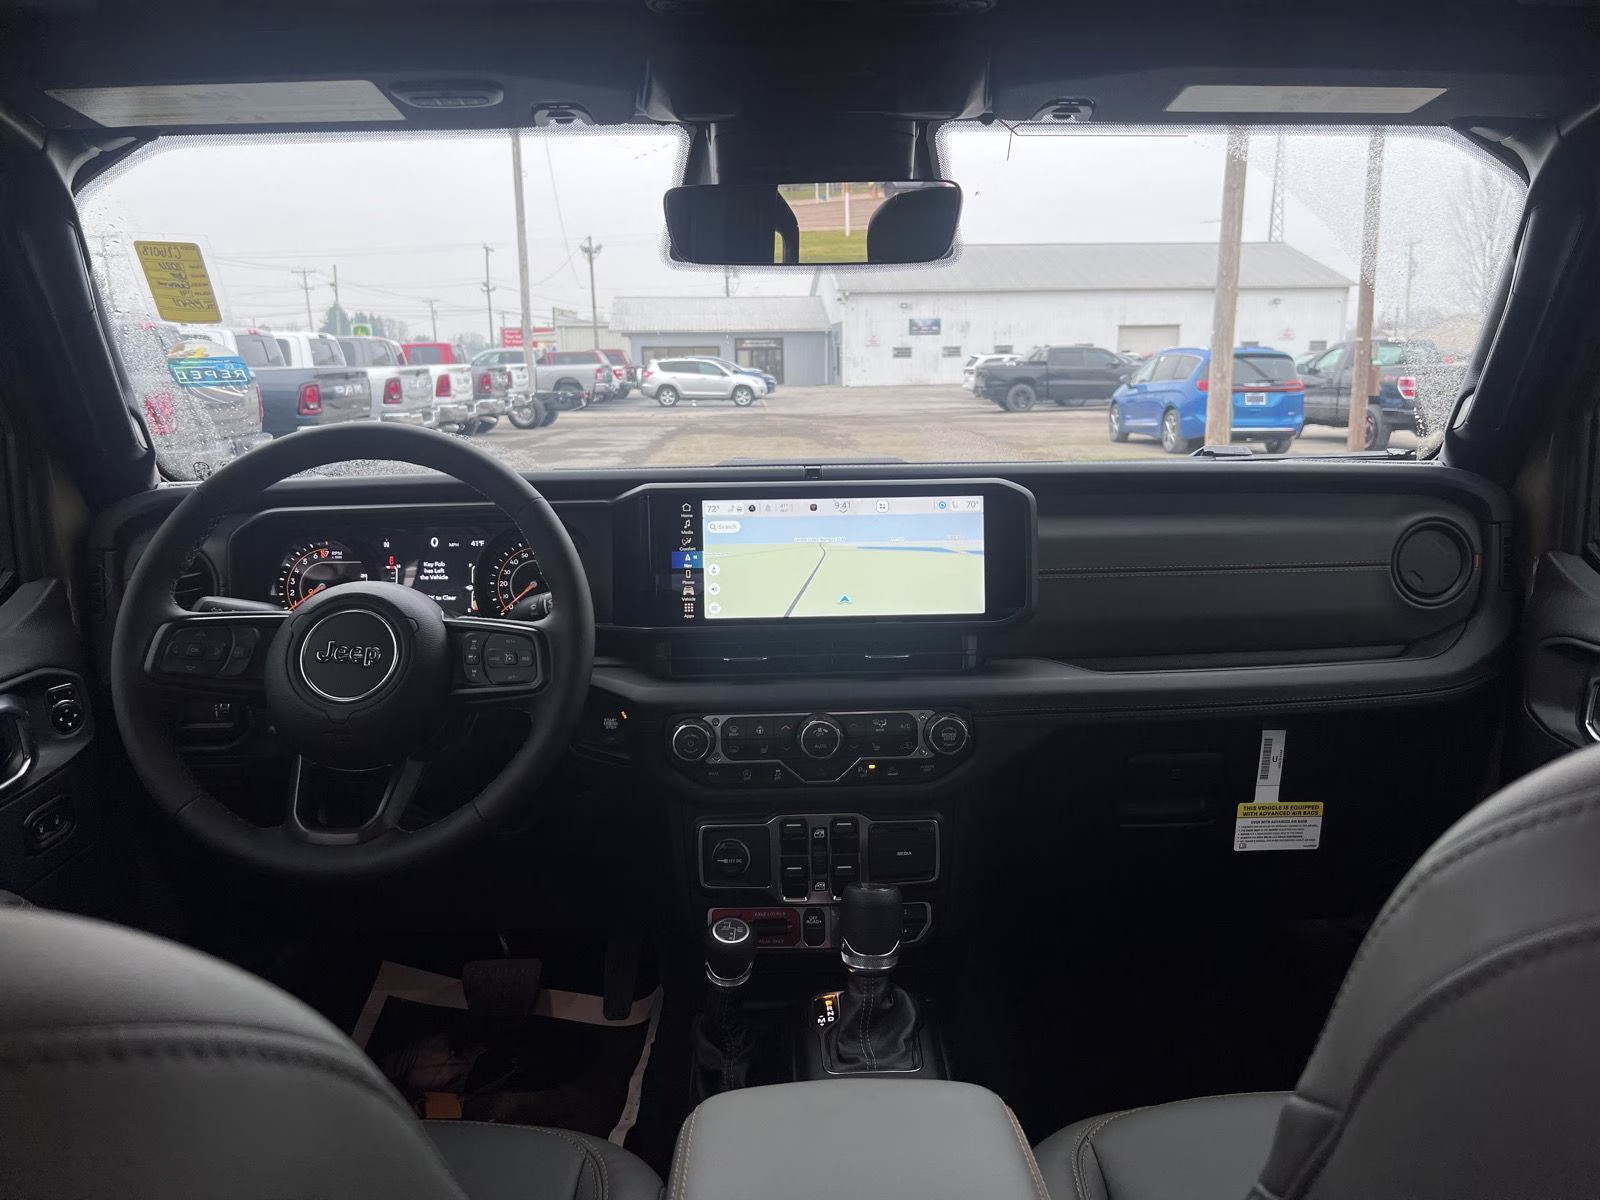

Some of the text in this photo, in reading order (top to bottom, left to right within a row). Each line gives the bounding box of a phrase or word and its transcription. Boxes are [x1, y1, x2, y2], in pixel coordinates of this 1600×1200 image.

[834, 501, 851, 510] 9:41
[966, 500, 979, 508] 70°
[430, 537, 438, 548] 0
[423, 561, 433, 569] Key
[316, 640, 382, 666] Jeep
